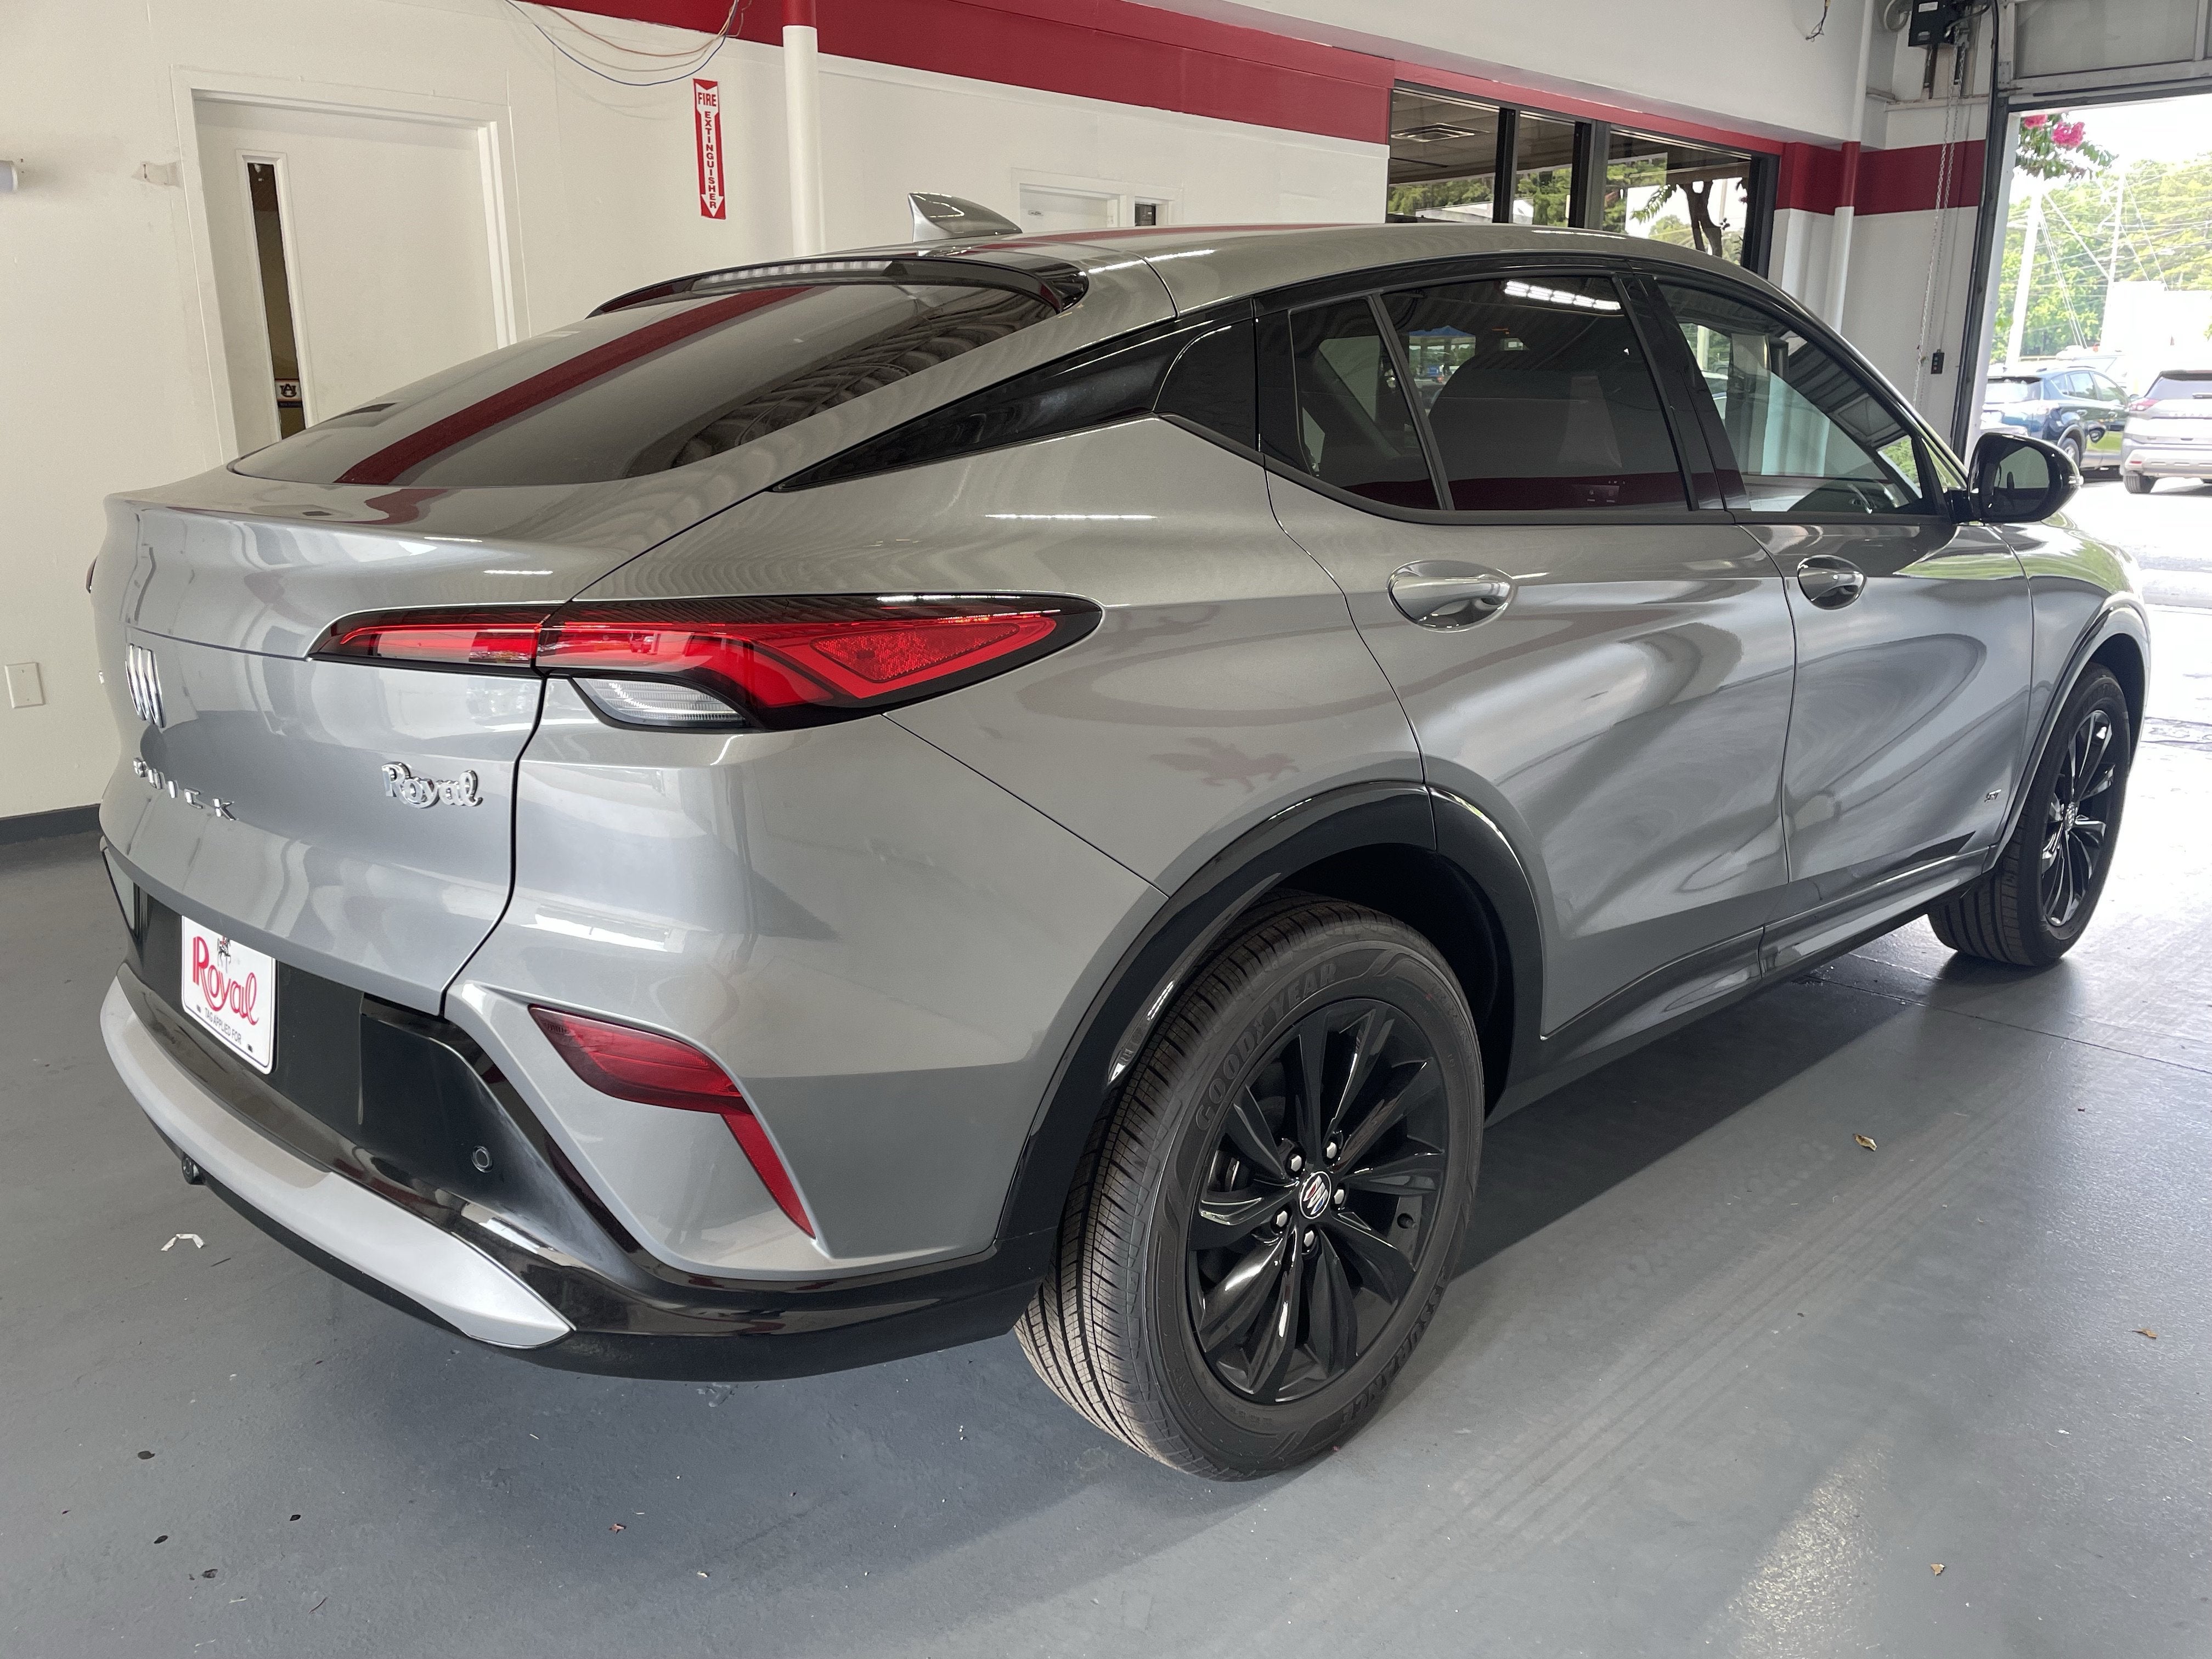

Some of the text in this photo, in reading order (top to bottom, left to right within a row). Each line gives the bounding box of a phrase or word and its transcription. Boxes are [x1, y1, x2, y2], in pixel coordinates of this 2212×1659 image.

[697, 92, 716, 107] FIRE
[704, 111, 716, 209] EXTINGUISHER
[132, 757, 238, 821] BUICK
[382, 761, 483, 809] Royal
[193, 936, 259, 1025] Royal
[205, 1007, 241, 1045] TAG APPLIED FOR
[1195, 962, 1337, 1131] GOODYEAR
